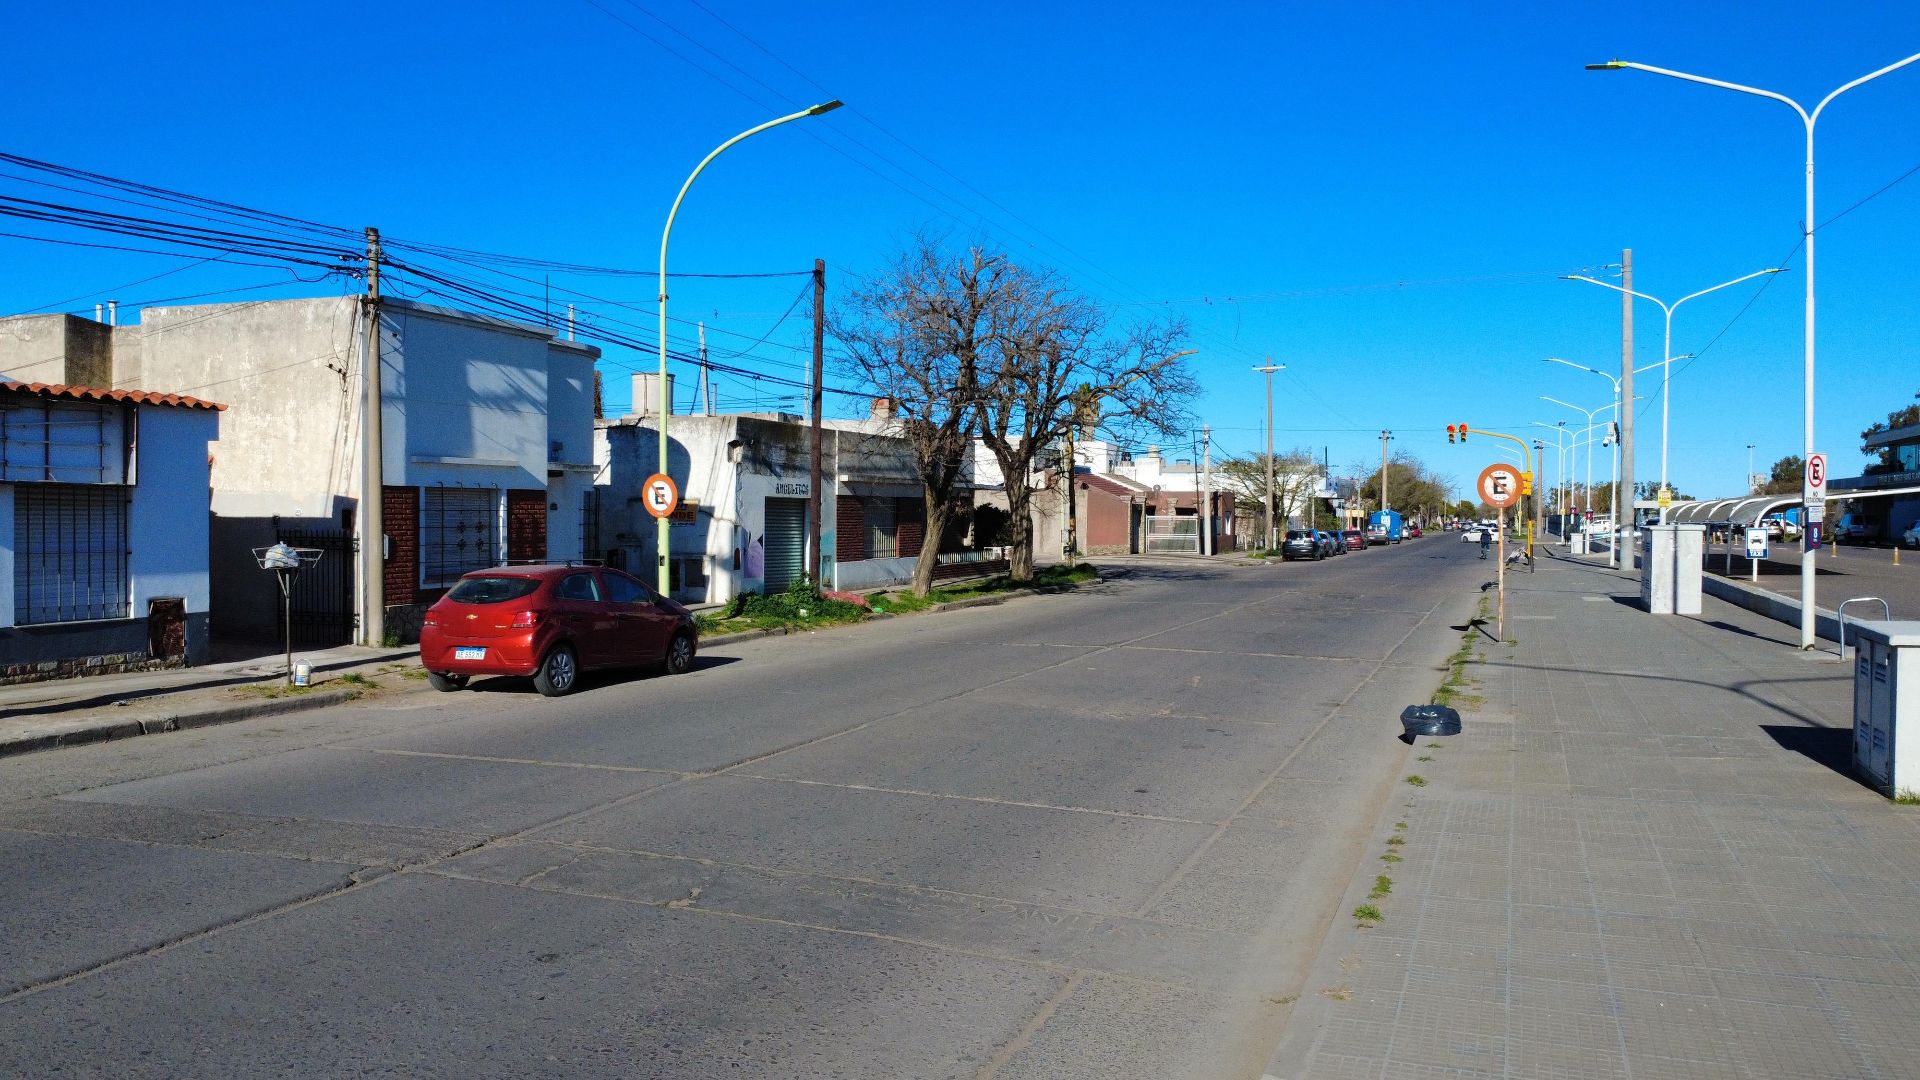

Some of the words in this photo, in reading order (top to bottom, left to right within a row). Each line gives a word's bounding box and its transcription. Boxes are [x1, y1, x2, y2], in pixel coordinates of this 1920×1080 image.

[1812, 463, 1820, 480] E
[1493, 476, 1507, 495] E
[654, 486, 665, 505] E
[1813, 527, 1818, 538] 8
